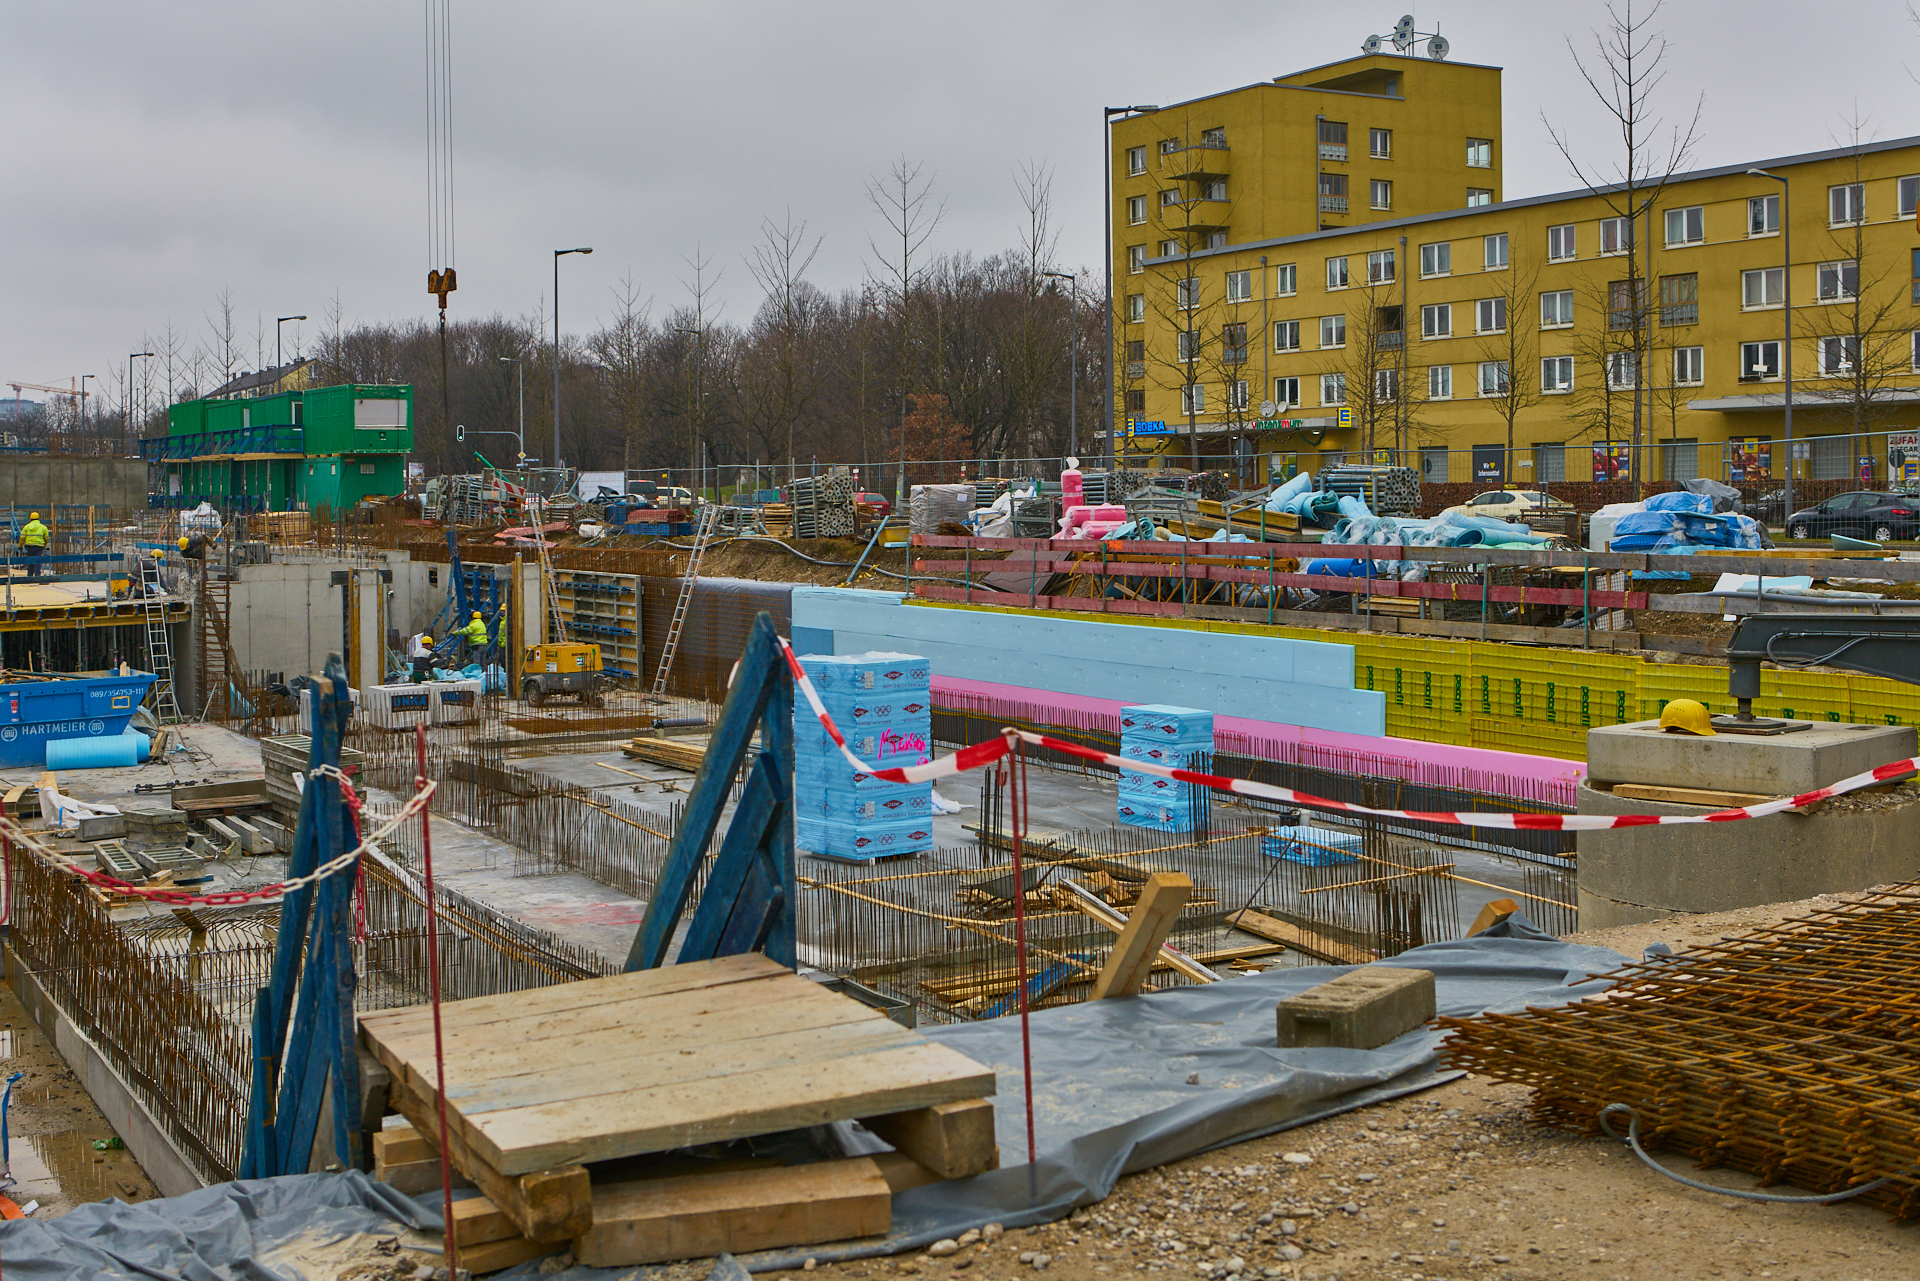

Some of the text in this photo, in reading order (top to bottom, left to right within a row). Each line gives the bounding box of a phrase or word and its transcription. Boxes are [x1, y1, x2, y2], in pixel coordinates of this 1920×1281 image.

[1340, 410, 1350, 422] E
[1135, 421, 1165, 432] EDEKA
[1251, 419, 1302, 429] vinzenzmurr
[22, 722, 86, 735] HARTMEIER
